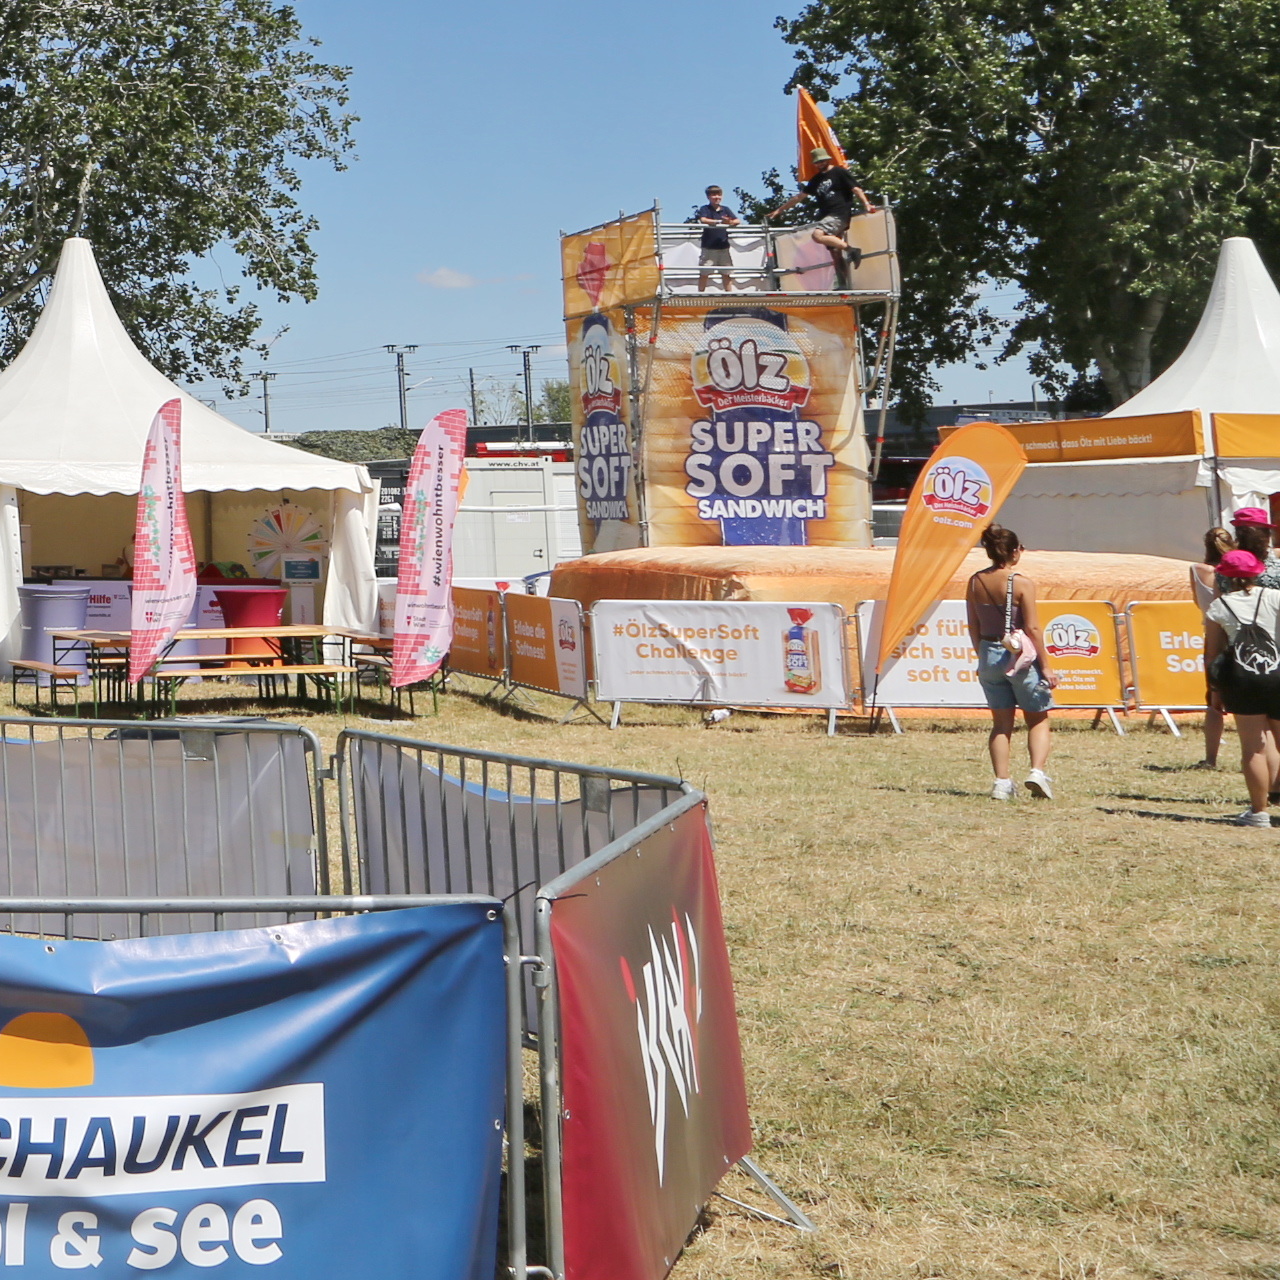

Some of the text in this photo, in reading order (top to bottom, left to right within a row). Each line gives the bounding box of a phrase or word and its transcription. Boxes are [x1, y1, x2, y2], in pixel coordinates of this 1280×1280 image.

[585, 344, 615, 397] Ölz
[707, 337, 791, 394] Ölz
[717, 392, 789, 407] Der Meisterbäcker
[579, 422, 628, 456] SUPER
[691, 420, 824, 453] SUPER
[1061, 439, 1079, 448] dass
[1093, 437, 1106, 446] mit
[1107, 435, 1128, 445] Liebe
[578, 455, 631, 499] SOFT
[685, 452, 835, 498] SOFT
[934, 466, 981, 506] Ölz
[432, 444, 444, 587] #wienwohntbesser
[586, 500, 629, 519] SANDWICH
[698, 499, 826, 519] SANDWICH
[933, 516, 973, 529] oelz.com
[534, 622, 546, 640] die
[612, 618, 760, 642] #ÖlzSuperSoft
[936, 619, 971, 637] füh
[1051, 623, 1091, 649] Ölz
[515, 639, 547, 660] Softness!
[1159, 631, 1205, 649] Erle
[635, 643, 739, 665] Challenge
[891, 641, 980, 664] sich sup
[907, 665, 951, 682] soft
[50, 1211, 104, 1271] &
[127, 1198, 284, 1270] see
